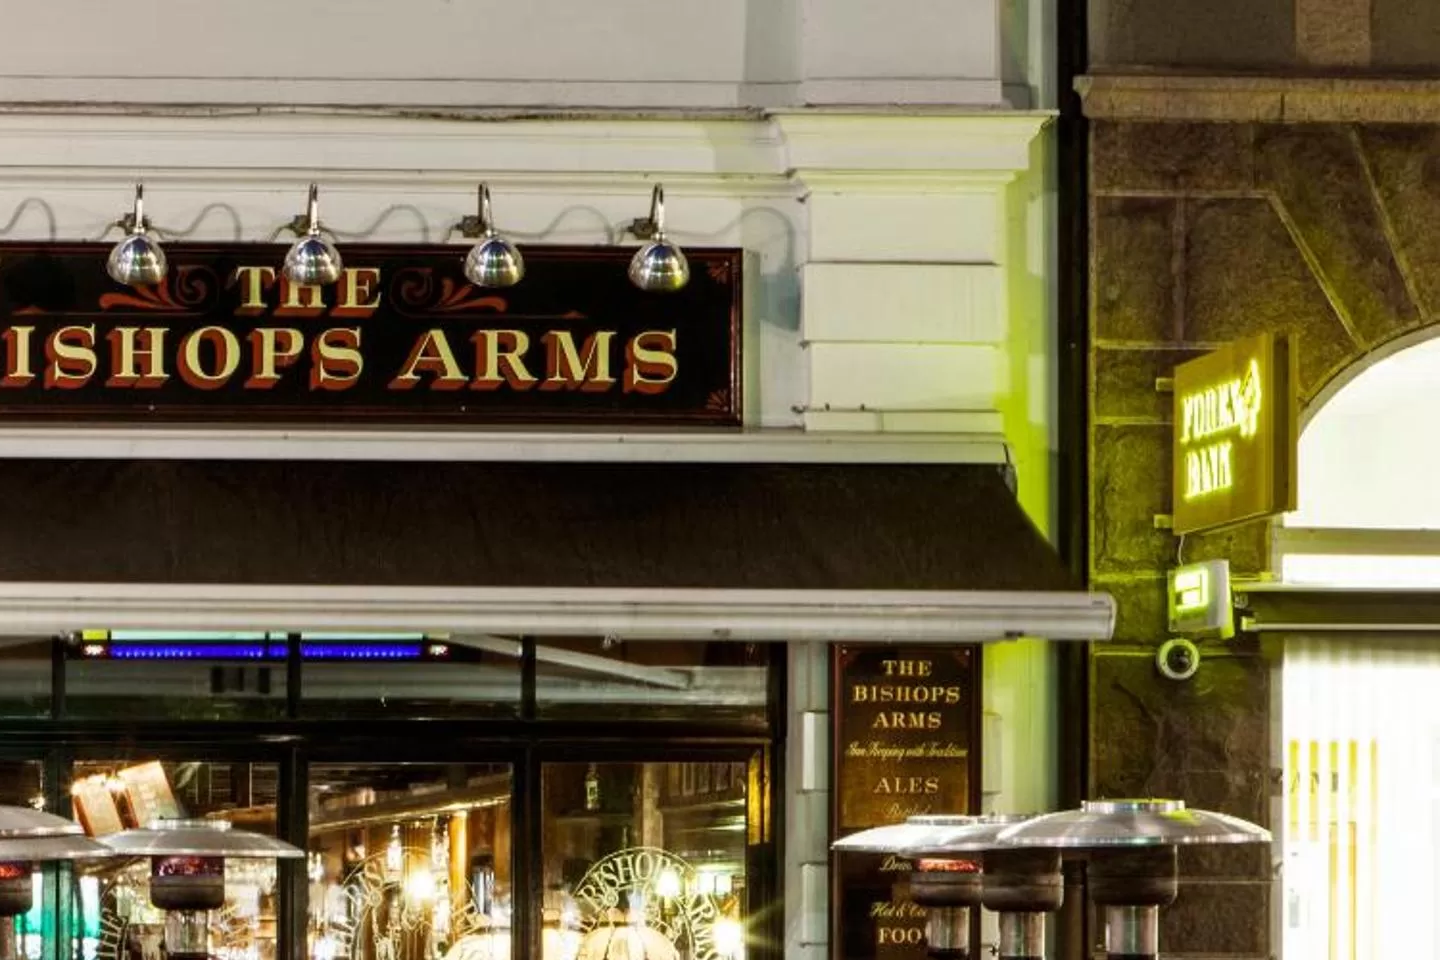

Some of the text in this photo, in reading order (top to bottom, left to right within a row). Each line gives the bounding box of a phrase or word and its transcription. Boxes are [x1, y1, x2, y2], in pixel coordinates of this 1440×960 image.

[234, 265, 382, 316] THE
[390, 327, 679, 393] ARMS
[882, 660, 932, 677] THE
[853, 685, 960, 703] BISHOPS
[872, 711, 941, 729] ARMS
[873, 777, 939, 795] ALES
[878, 927, 922, 945] FOO
